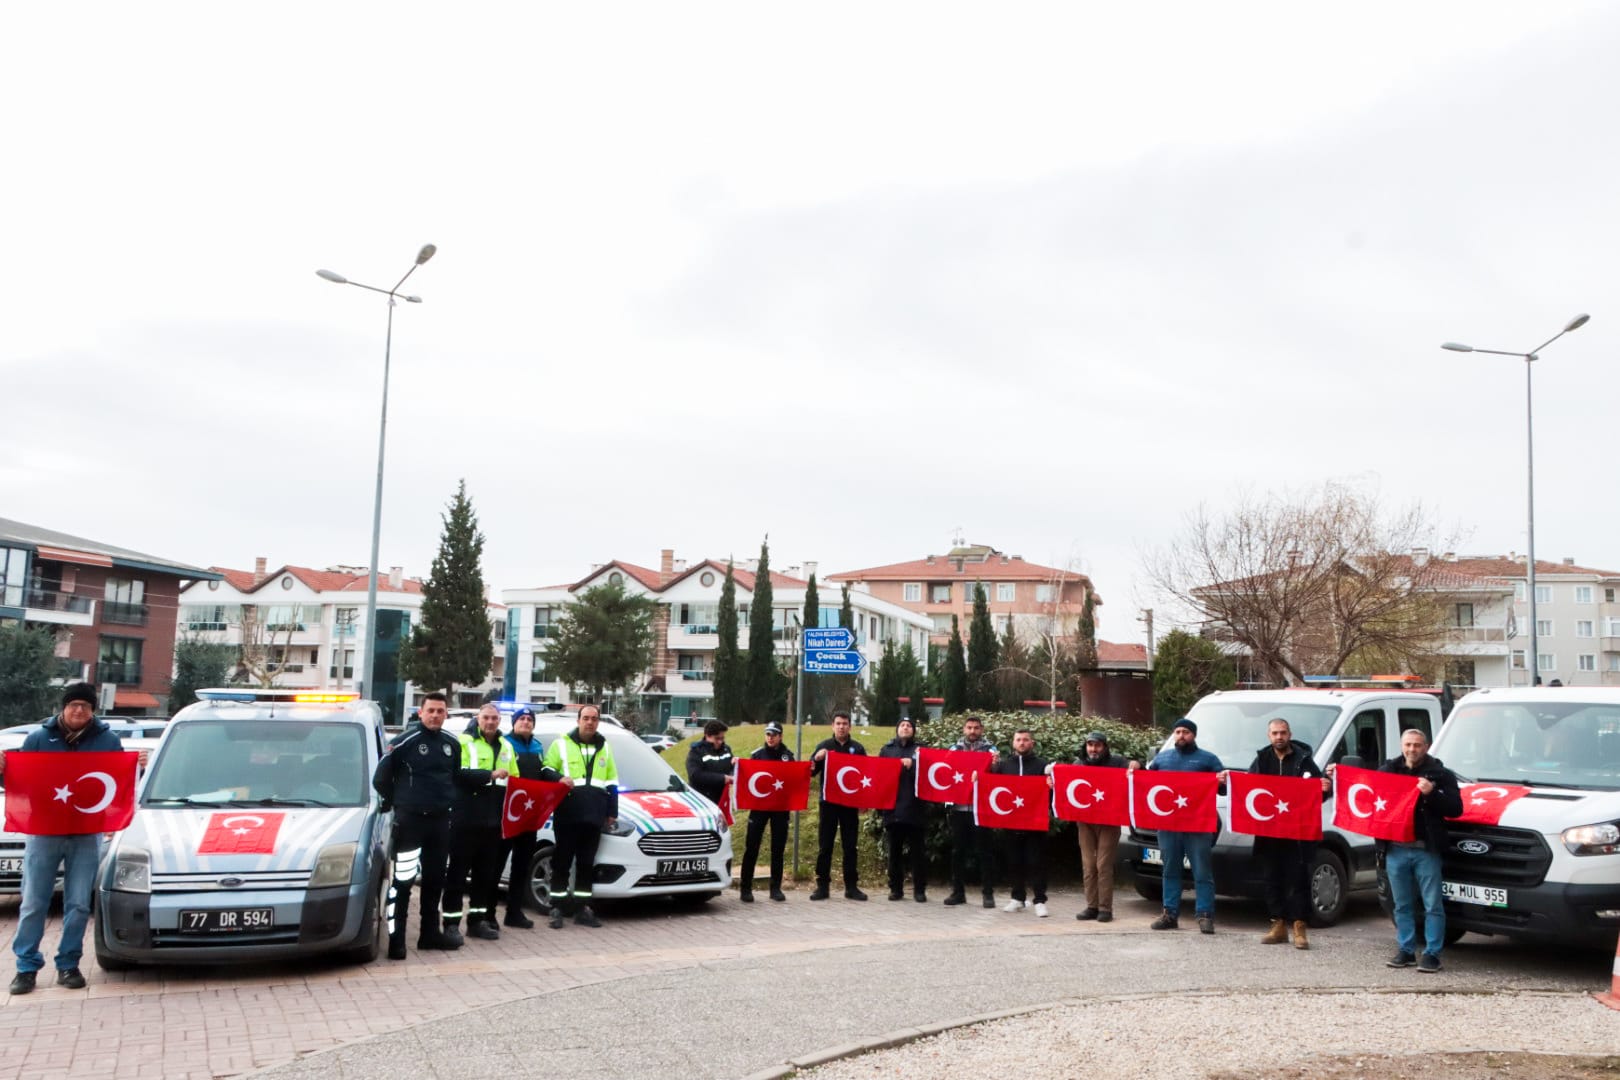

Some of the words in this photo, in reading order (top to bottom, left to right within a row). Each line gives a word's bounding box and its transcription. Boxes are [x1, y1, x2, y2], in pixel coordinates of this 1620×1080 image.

[807, 638, 824, 647] Nikah
[826, 638, 847, 647] Dairesi
[816, 652, 846, 661] Çocuk
[807, 661, 854, 670] Tiyatrosu
[663, 861, 673, 872] 77
[676, 860, 690, 872] ACA
[692, 860, 706, 871] 456
[1442, 883, 1454, 895] 34
[1459, 885, 1479, 899] MUL
[1484, 888, 1505, 902] 955
[190, 913, 208, 928] 77
[220, 912, 237, 926] DR
[243, 911, 269, 926] 594
